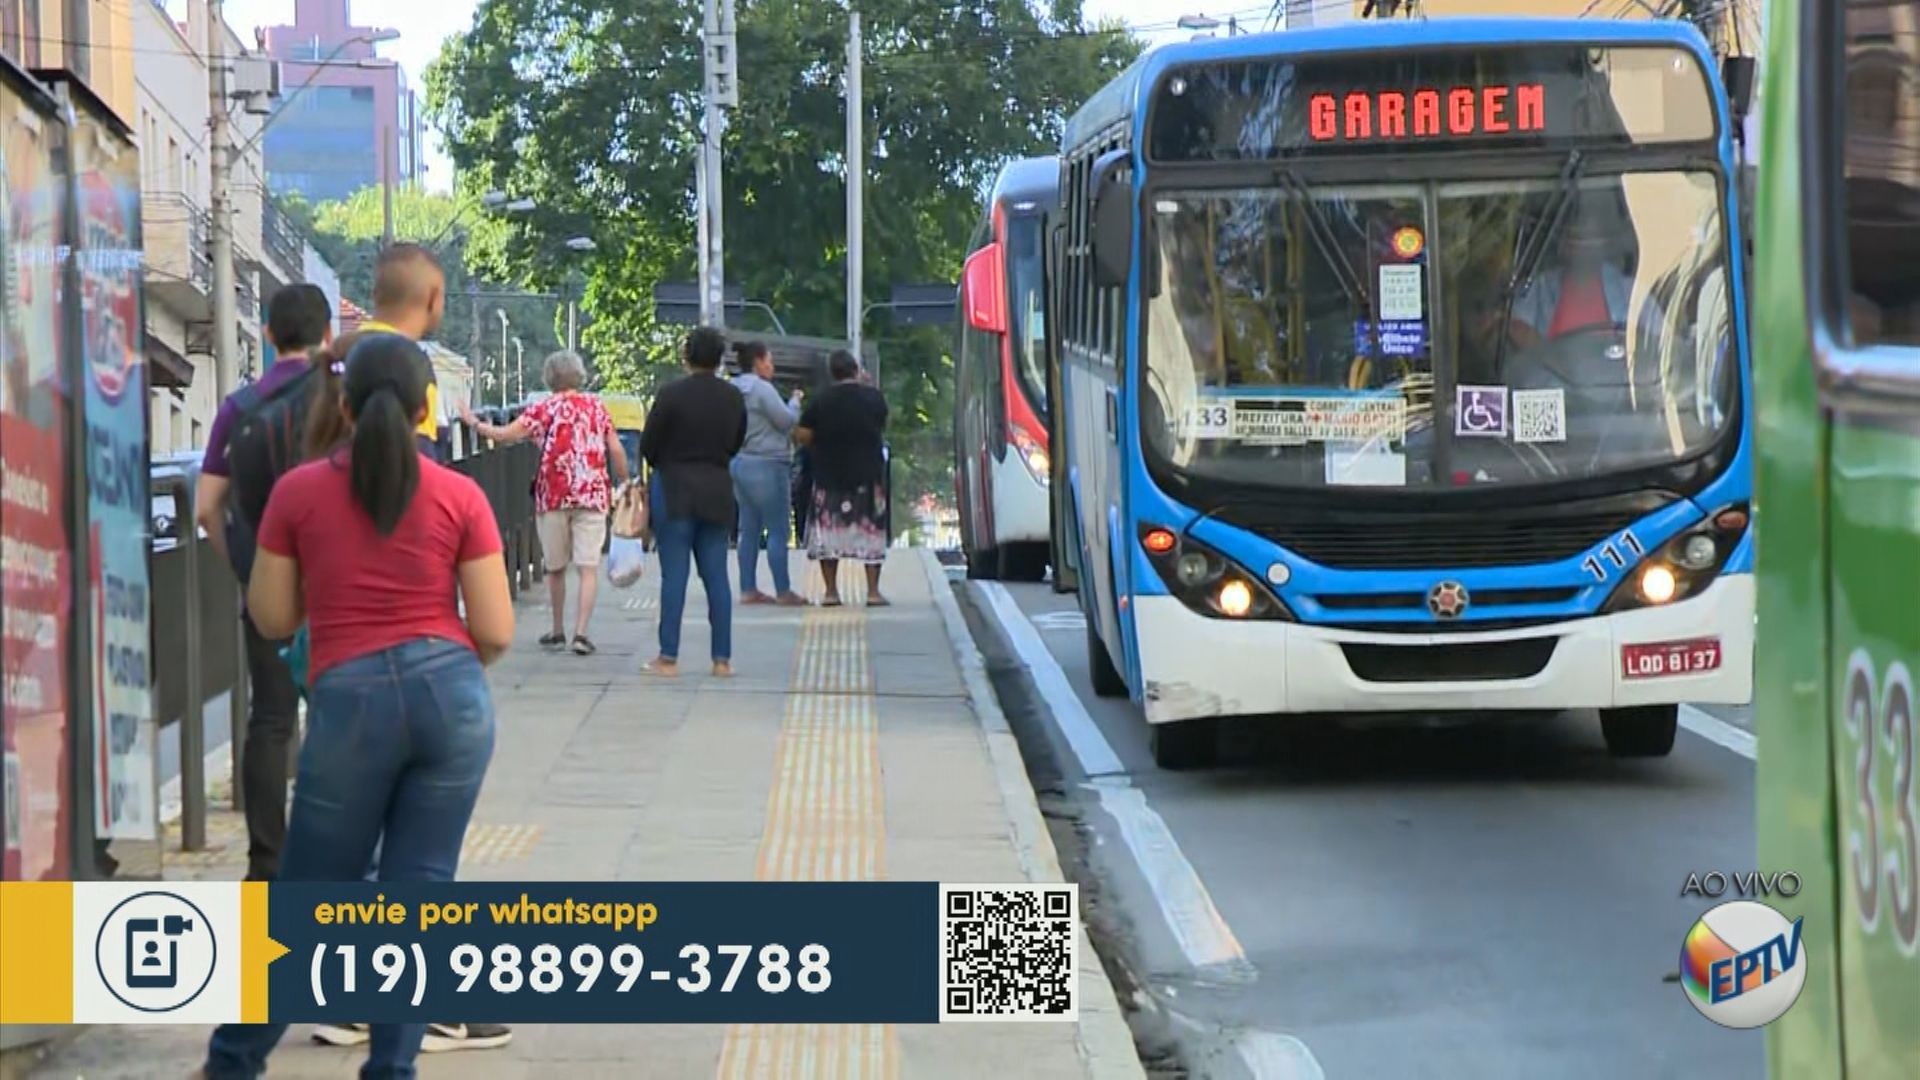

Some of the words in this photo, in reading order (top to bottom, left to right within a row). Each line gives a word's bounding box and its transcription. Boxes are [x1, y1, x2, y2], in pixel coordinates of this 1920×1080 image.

[1310, 83, 1545, 140] GARAGEM
[1236, 412, 1304, 424] PREFEITURA
[1582, 529, 1645, 581] 111
[1669, 650, 1716, 671] 8137
